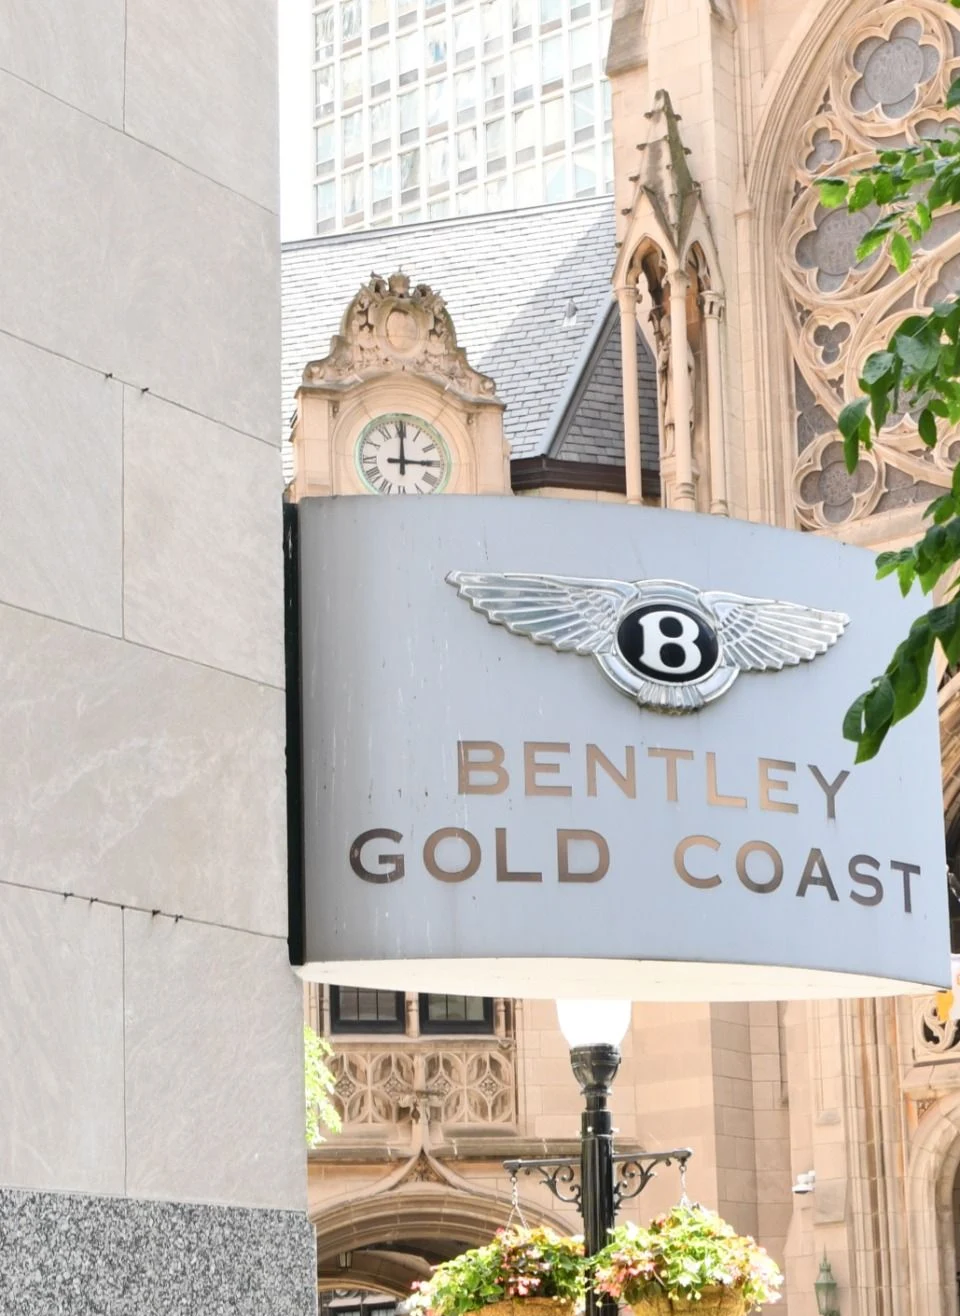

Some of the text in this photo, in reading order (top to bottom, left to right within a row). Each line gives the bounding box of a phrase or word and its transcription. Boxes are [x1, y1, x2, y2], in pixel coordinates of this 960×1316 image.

[638, 609, 703, 675] B
[456, 739, 851, 820] BENTLEY
[349, 827, 921, 914] GOLD COAST
